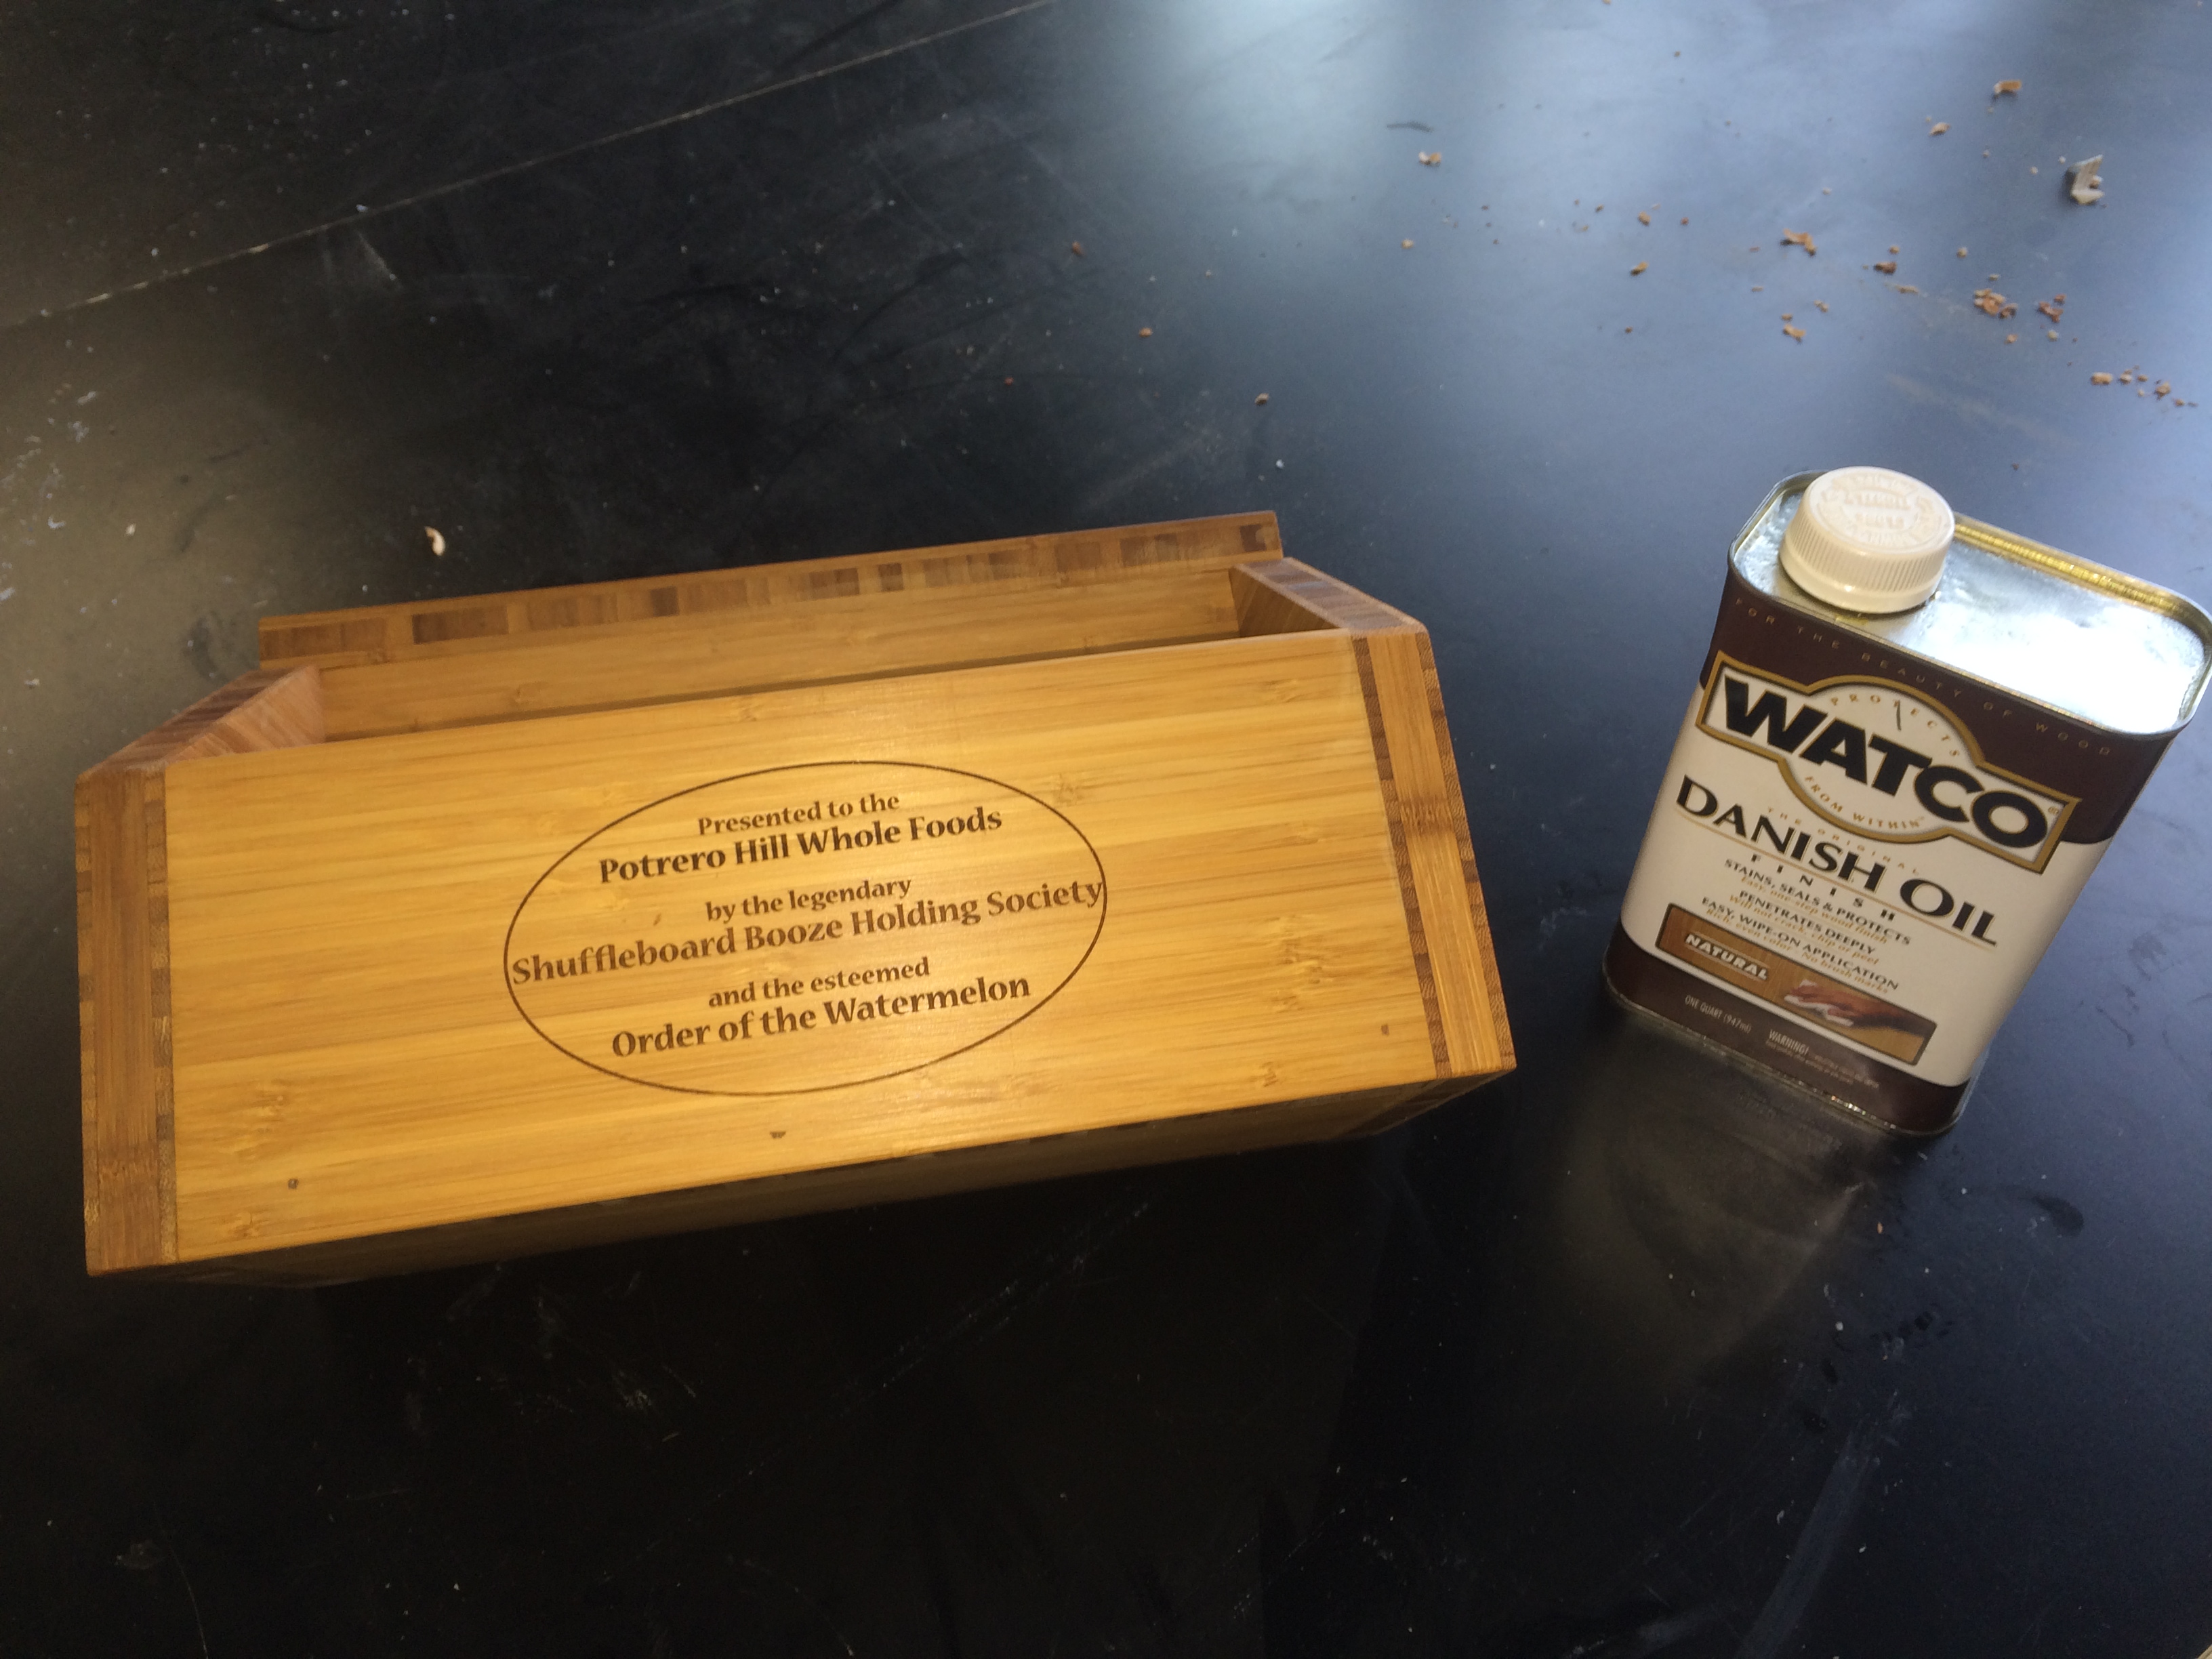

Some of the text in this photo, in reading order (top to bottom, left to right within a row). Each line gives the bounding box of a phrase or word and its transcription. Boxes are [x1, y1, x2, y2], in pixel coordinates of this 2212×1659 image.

[1736, 598, 2110, 756] FOR THE BEAUTY OF WOOD
[1830, 693, 1960, 757] PROTECTS
[1724, 675, 2049, 848] WATCO
[698, 793, 900, 836] Presented to the
[1804, 775, 1920, 830] FROM WITHIN
[600, 806, 1003, 884] Potrero Hill Whole Foods
[1676, 775, 1997, 948] DANISH OIL
[1767, 806, 1919, 874] THE ORIGINAL
[705, 879, 912, 924] by the legendary
[1725, 859, 1910, 945] STAINS, SEALS & PROTECTS
[1751, 854, 1896, 922] FINISH
[512, 880, 1105, 985] Shuffleboard Booze Holding Society
[1729, 895, 1753, 909] Will
[1754, 907, 1772, 918] not
[1852, 951, 1879, 965] peel
[1740, 890, 1875, 954] PENETRATES DEEPLY
[1740, 914, 1801, 947] WIPE-ON
[1803, 943, 1899, 990] APPLICATION
[1822, 912, 1853, 928] wood
[1855, 925, 1887, 944] finish
[708, 956, 930, 1008] and the esteemed
[1685, 933, 1769, 981] NATURAL
[1820, 960, 1851, 977] brush
[612, 976, 1031, 1057] Order of the Watermelon
[1685, 995, 1700, 1009] ONE
[1700, 1002, 1723, 1019] QUART
[1769, 1029, 1809, 1057] WARNING!
